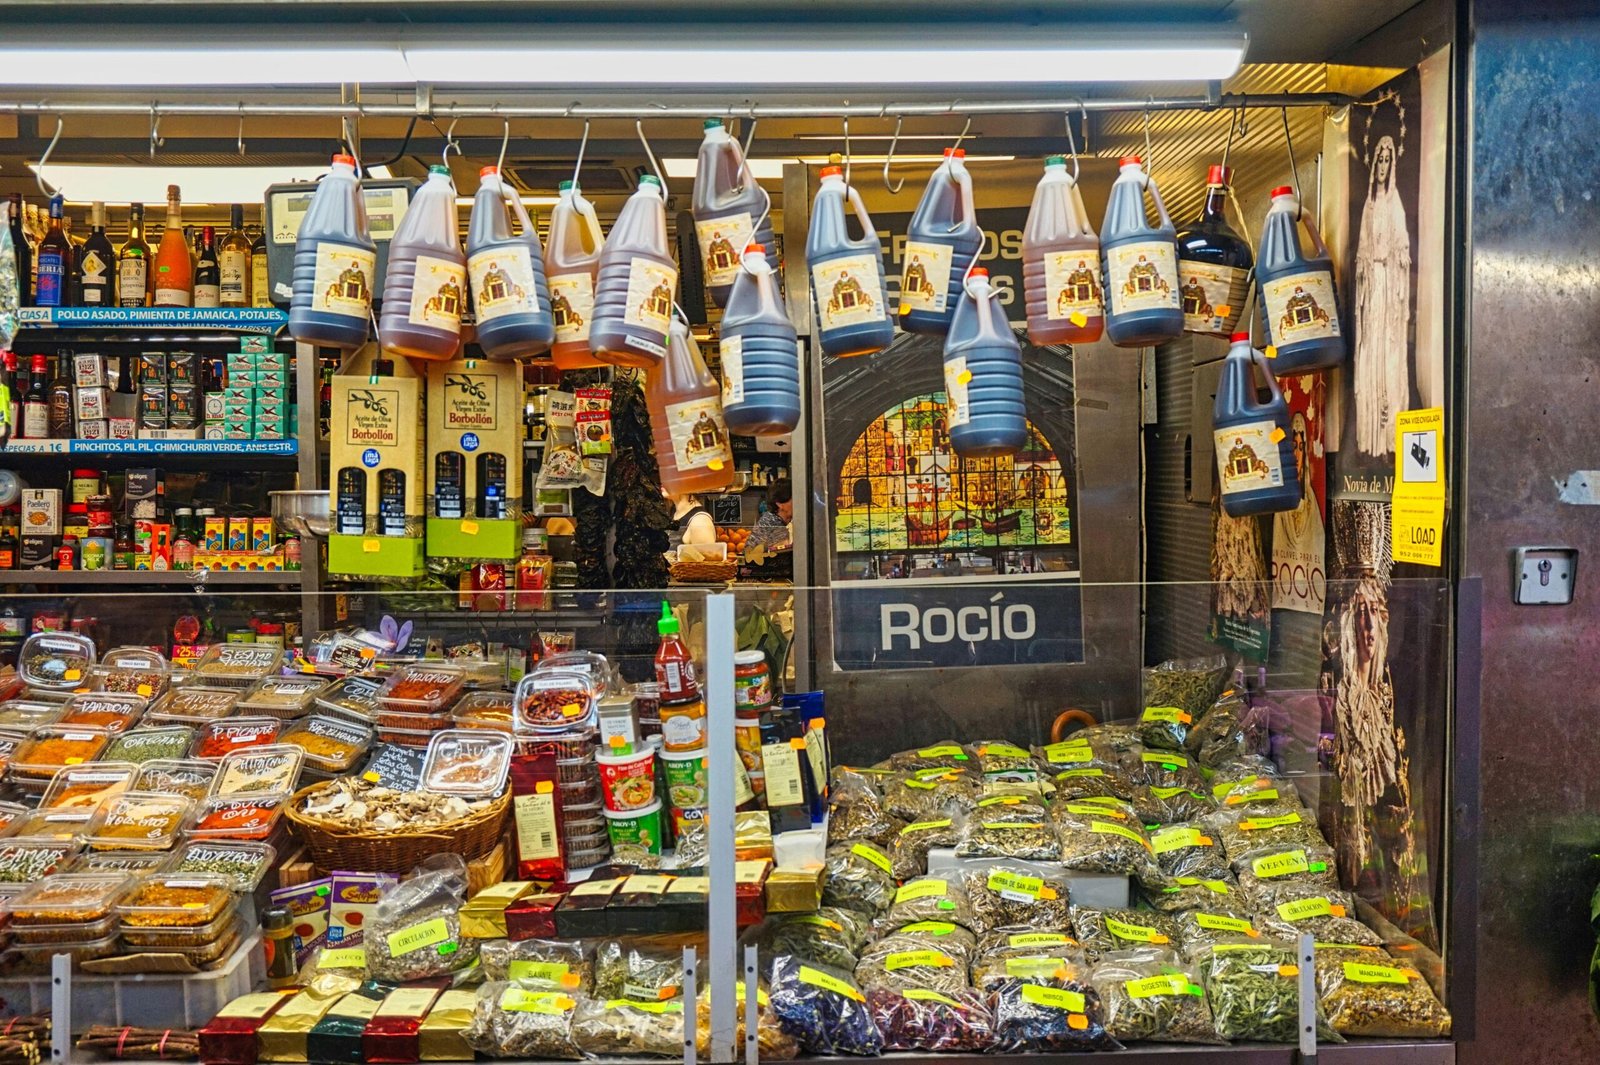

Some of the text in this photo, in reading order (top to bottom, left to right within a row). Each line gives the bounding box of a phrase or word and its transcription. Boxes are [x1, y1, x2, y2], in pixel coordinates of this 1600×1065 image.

[58, 310, 284, 322] POLLO ASADO, PIMIENTA DE JAMAICA, POTAJES,
[449, 412, 492, 424] Borbollón
[352, 428, 394, 440] Borbollón
[50, 442, 62, 452] 1€
[74, 443, 122, 452] PINCHITOS,
[124, 443, 137, 452] PIL
[139, 443, 153, 452] PIL,
[154, 443, 212, 452] CHIMICHURRI
[214, 443, 244, 452] VERDE,
[268, 443, 294, 451] ESTR.
[1343, 474, 1394, 494] Novia de M
[1412, 526, 1436, 545] LOAD
[1260, 856, 1307, 870] VERVENA
[992, 876, 1008, 886] HIERBA
[1110, 924, 1148, 936] ORTIGA VERDE
[1359, 970, 1392, 978] MANZANILLA
